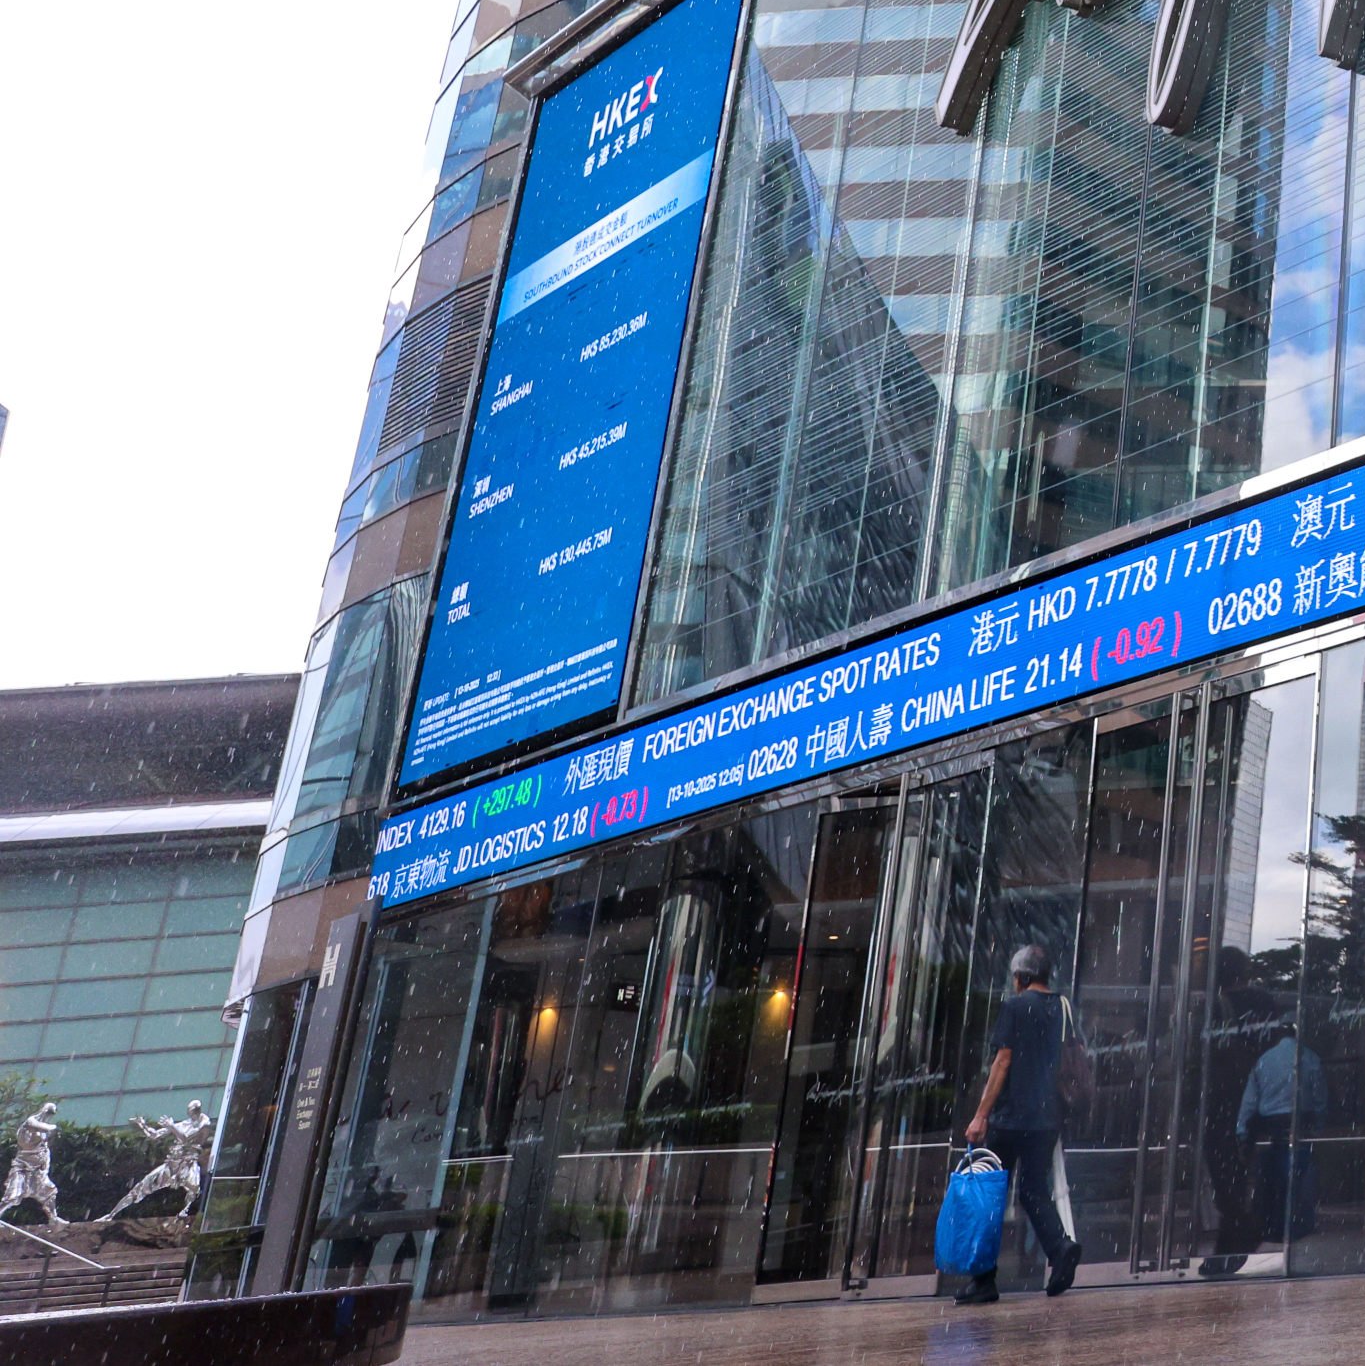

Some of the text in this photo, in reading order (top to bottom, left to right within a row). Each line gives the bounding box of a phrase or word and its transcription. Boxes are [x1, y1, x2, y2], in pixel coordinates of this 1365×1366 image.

[588, 66, 664, 149] HKEX
[583, 113, 655, 178] 香港交易所
[521, 195, 680, 307] SOUTHBOUND STOCK CONNECT TURNOVER
[490, 380, 533, 416] SHANGHAI
[468, 483, 515, 519] SHENZHEN
[447, 601, 471, 625] TOTAL
[374, 819, 416, 855] INDEX
[418, 800, 467, 840] 4129.16
[563, 737, 635, 795] 外匯現價
[642, 712, 717, 763] FOREIGN
[717, 676, 817, 737] EXCHANGE
[818, 656, 873, 703] SPOT
[873, 631, 941, 684] RATES
[967, 601, 1021, 657] 港元
[1027, 585, 1077, 632] HKD
[1085, 554, 1158, 612] 7.7778
[1183, 518, 1263, 578] 7.7779
[1290, 481, 1356, 549] 澳元
[452, 845, 472, 875] JD
[471, 820, 547, 869] LOGISTICS
[552, 805, 589, 843] 12.18
[747, 736, 799, 781] 02628
[901, 683, 965, 733] CHINA
[969, 665, 1017, 711] LIFE
[1023, 642, 1083, 694] 21.14
[1208, 577, 1283, 635] 02688
